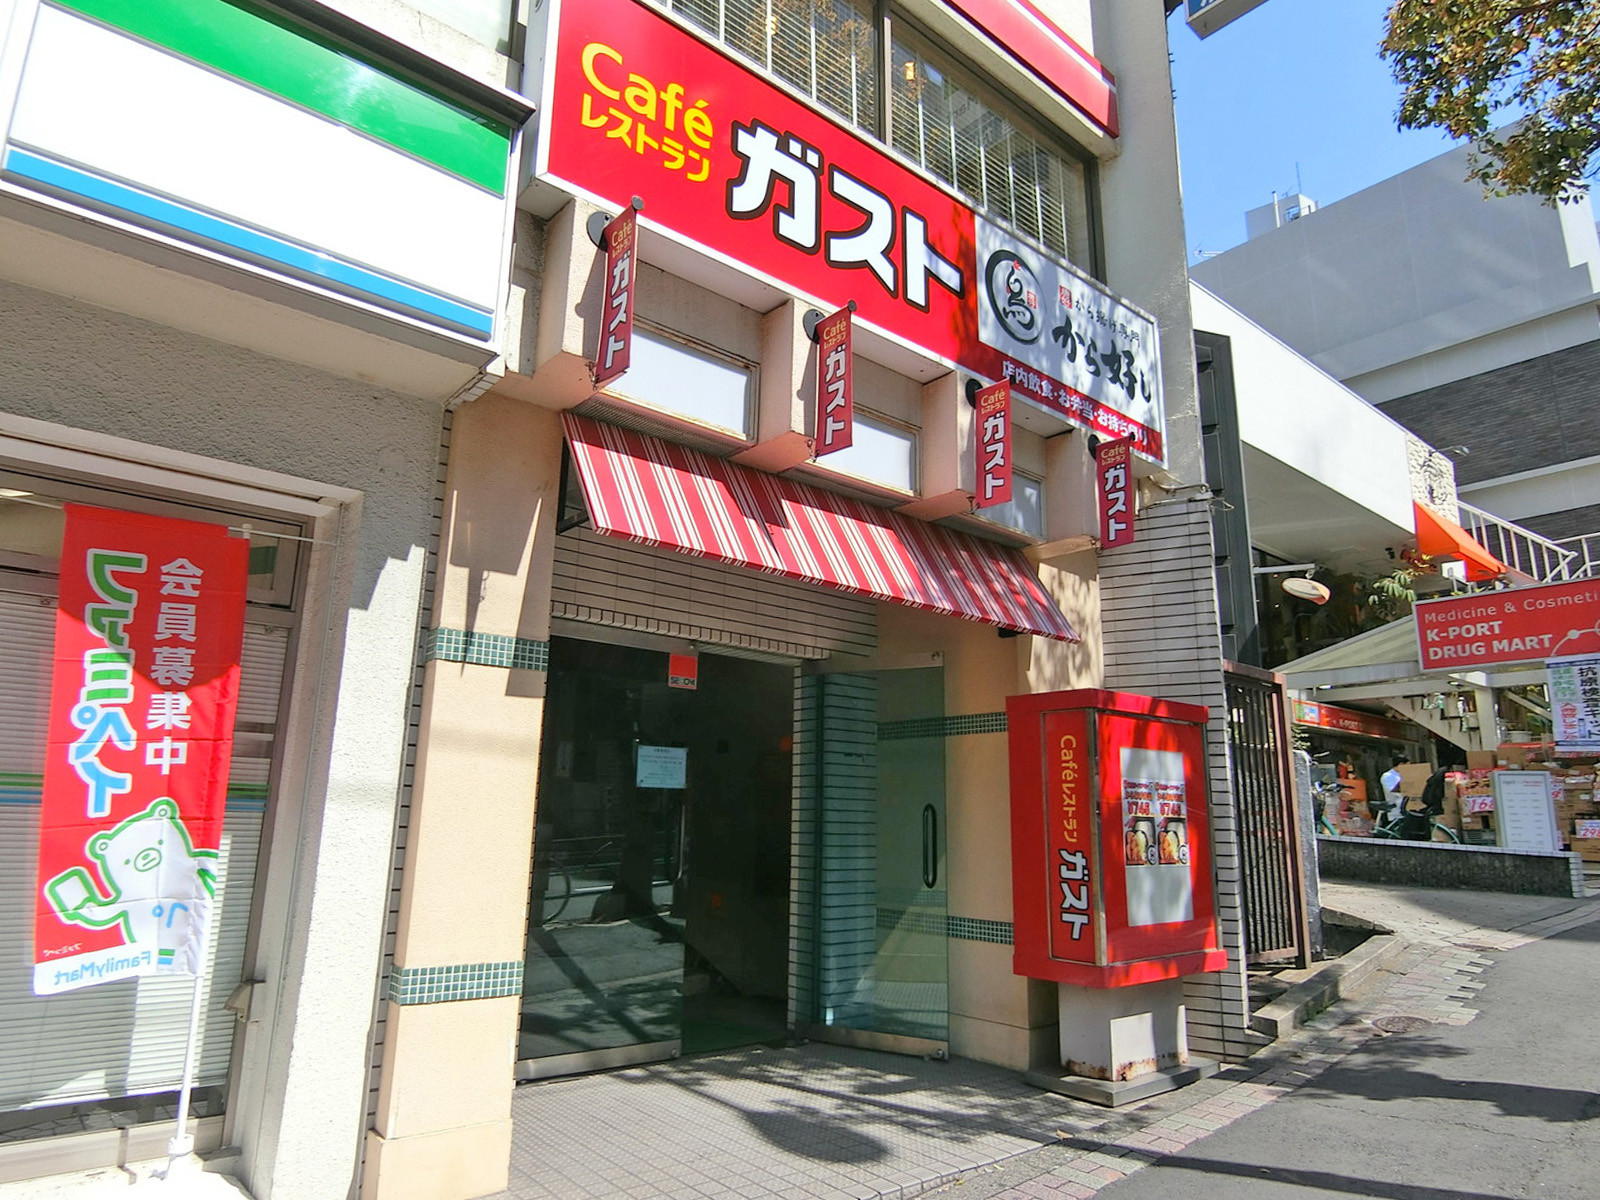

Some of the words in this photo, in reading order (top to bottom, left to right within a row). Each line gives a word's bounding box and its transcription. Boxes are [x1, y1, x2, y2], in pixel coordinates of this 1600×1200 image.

[580, 42, 714, 150] Café
[581, 93, 710, 182] レストラン
[725, 119, 965, 313] ガスト
[611, 219, 633, 247] Café
[612, 235, 632, 259] レストラン
[604, 250, 632, 370] ガスト
[823, 318, 847, 340] Café
[823, 333, 847, 350] レストラン
[1052, 315, 1151, 404] から好し
[824, 342, 848, 447] ガスト
[980, 388, 1006, 407] Café
[981, 400, 1006, 414] レストラン
[982, 410, 1006, 500] ガスト
[1100, 443, 1126, 459] Café
[1104, 462, 1127, 542] ガスト
[1425, 605, 1497, 624] Medicine
[1504, 602, 1517, 614] &
[1426, 621, 1502, 642] K-PORT
[1428, 642, 1486, 661] DRUG
[1492, 634, 1554, 654] MART
[1058, 848, 1091, 940] ガスト
